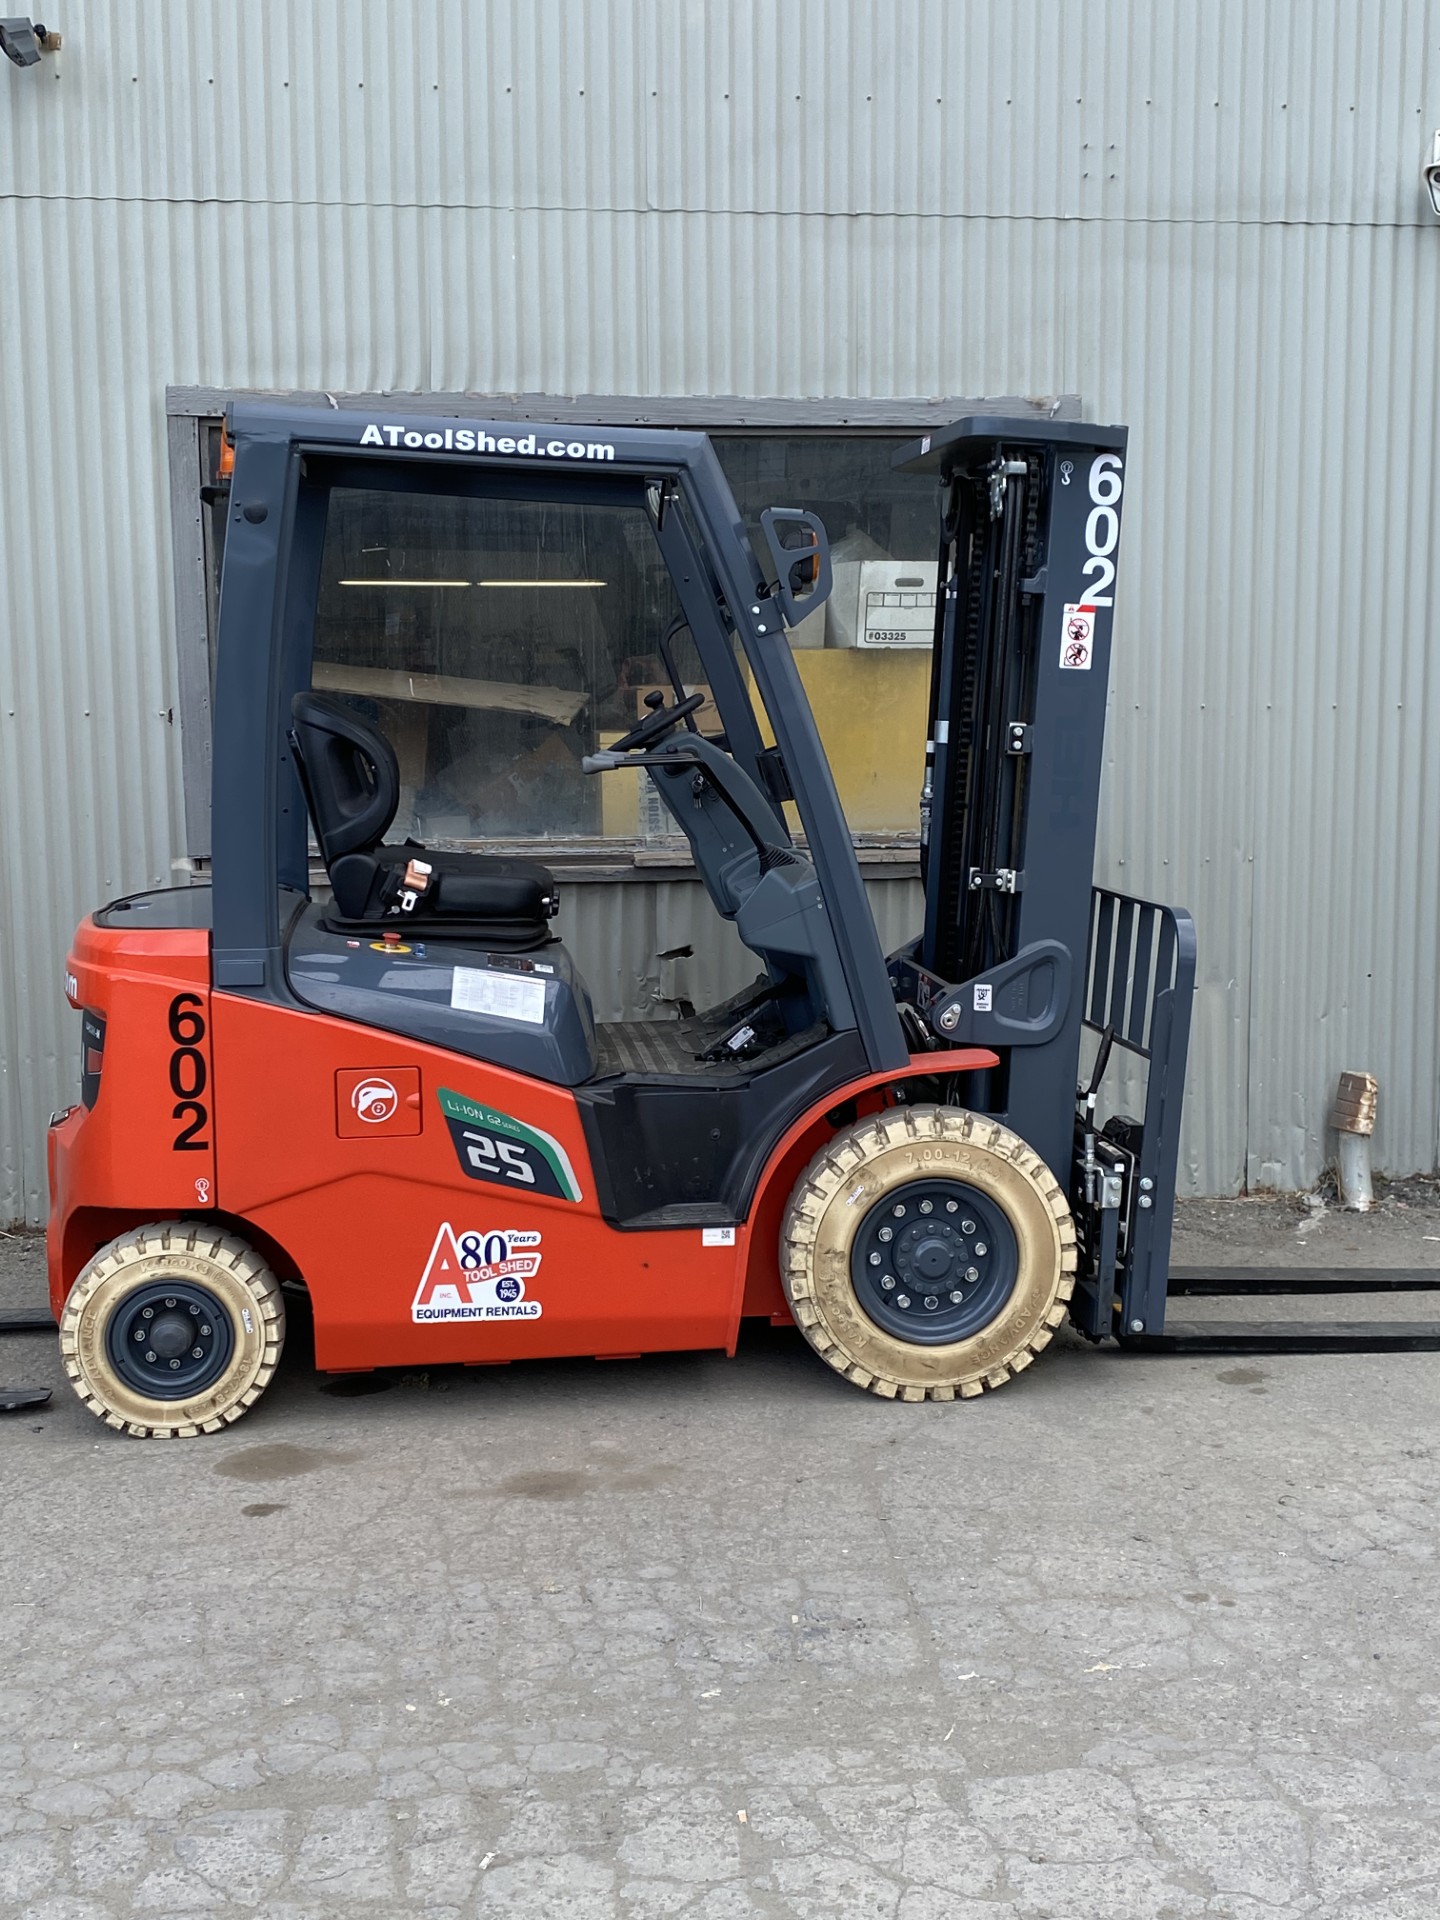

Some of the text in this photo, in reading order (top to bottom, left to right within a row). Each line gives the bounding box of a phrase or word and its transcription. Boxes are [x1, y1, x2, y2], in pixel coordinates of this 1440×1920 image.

[359, 424, 615, 460] AToolShed.com
[1079, 453, 1123, 607] 602
[868, 631, 907, 641] #03325
[168, 992, 209, 1151] 602
[462, 1130, 536, 1184] 25
[460, 1234, 538, 1270] 80 Years
[463, 1260, 533, 1282] TOOL SHED
[499, 1288, 517, 1299] 1945
[416, 1305, 538, 1319] EQUIPMENT RENTALS
